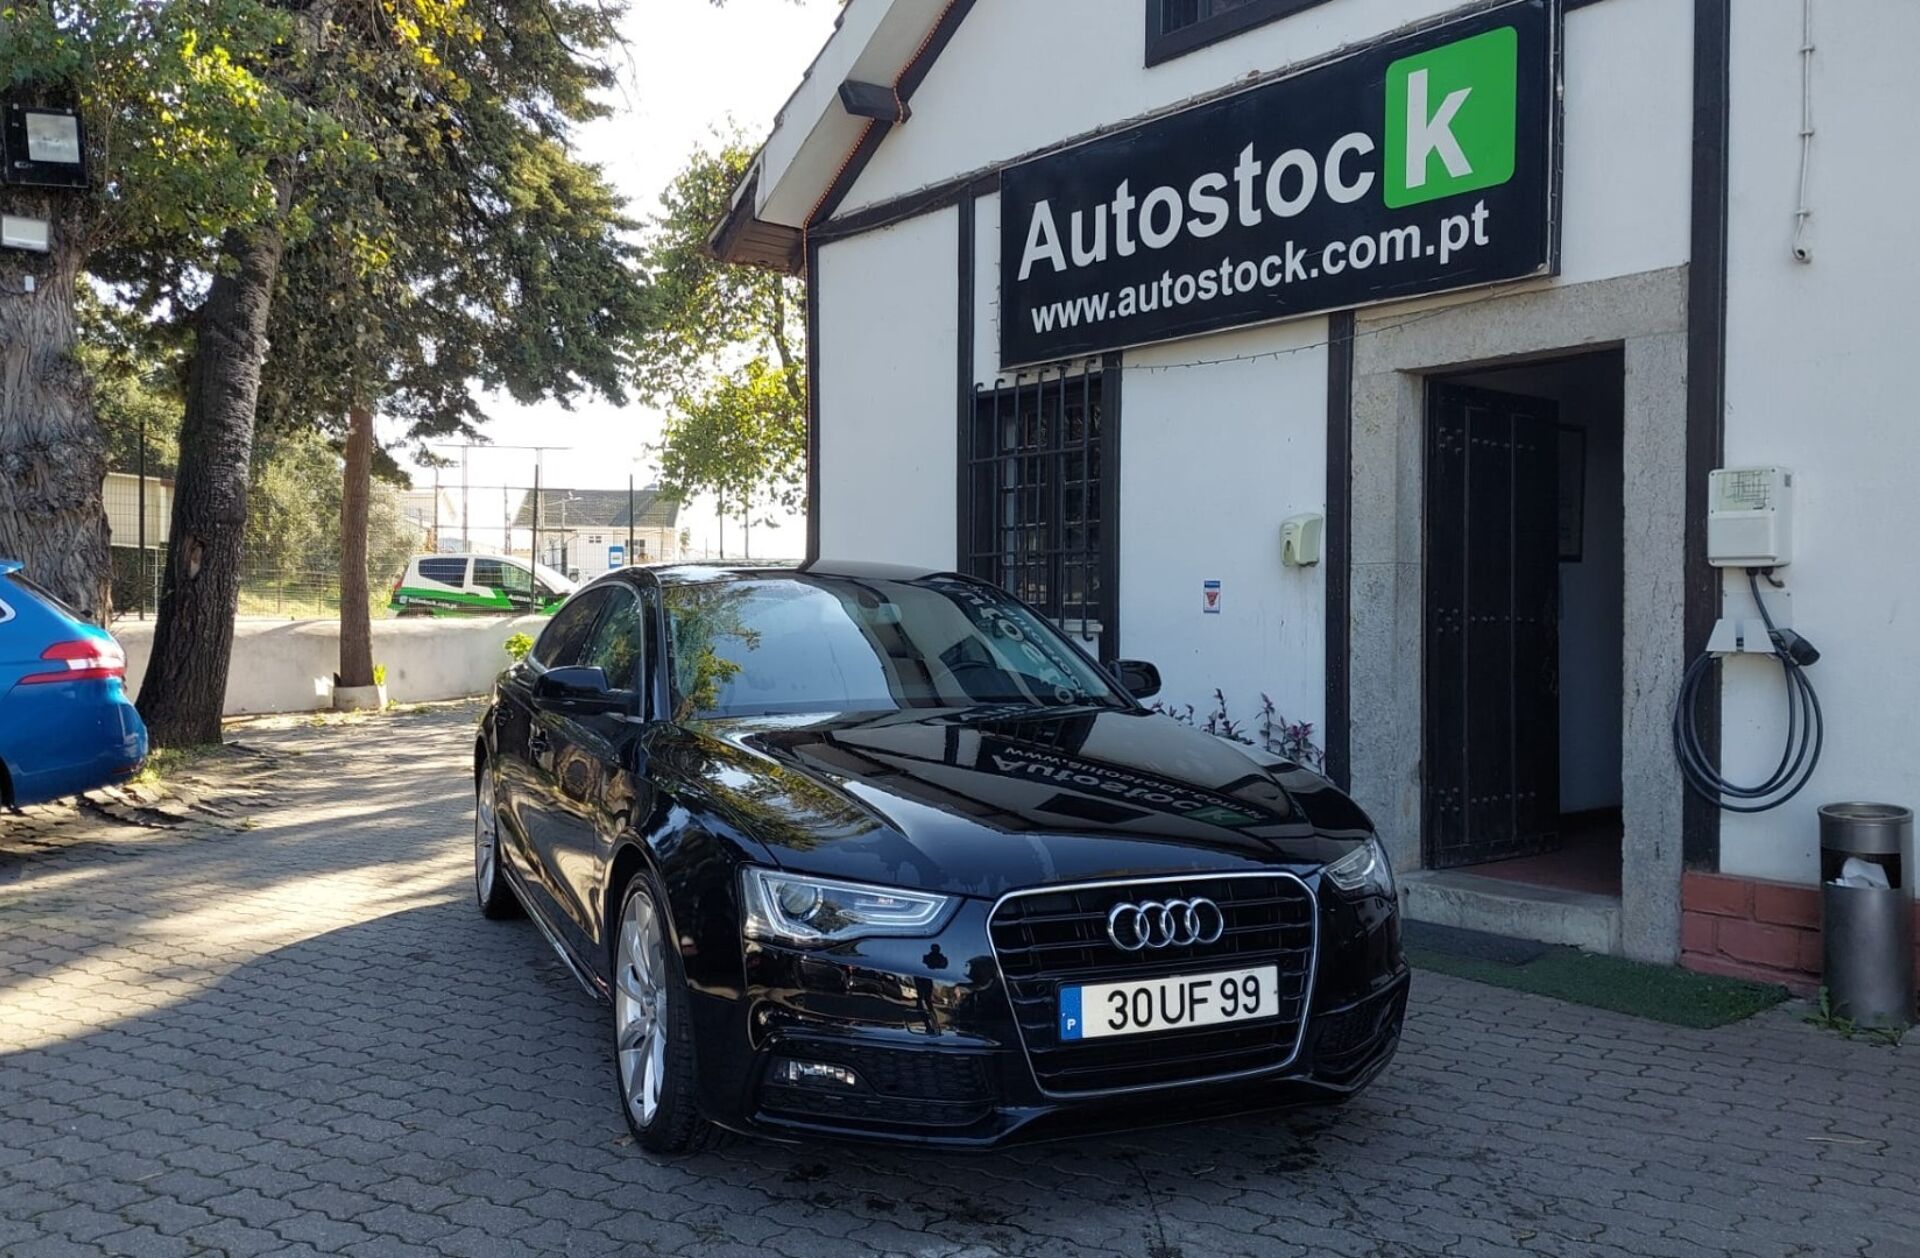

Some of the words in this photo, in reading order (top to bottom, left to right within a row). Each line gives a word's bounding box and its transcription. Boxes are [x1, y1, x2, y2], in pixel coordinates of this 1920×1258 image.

[1017, 68, 1474, 281] Autostock
[1030, 200, 1490, 334] www.autostock.com.pt
[1066, 1018, 1076, 1031] P
